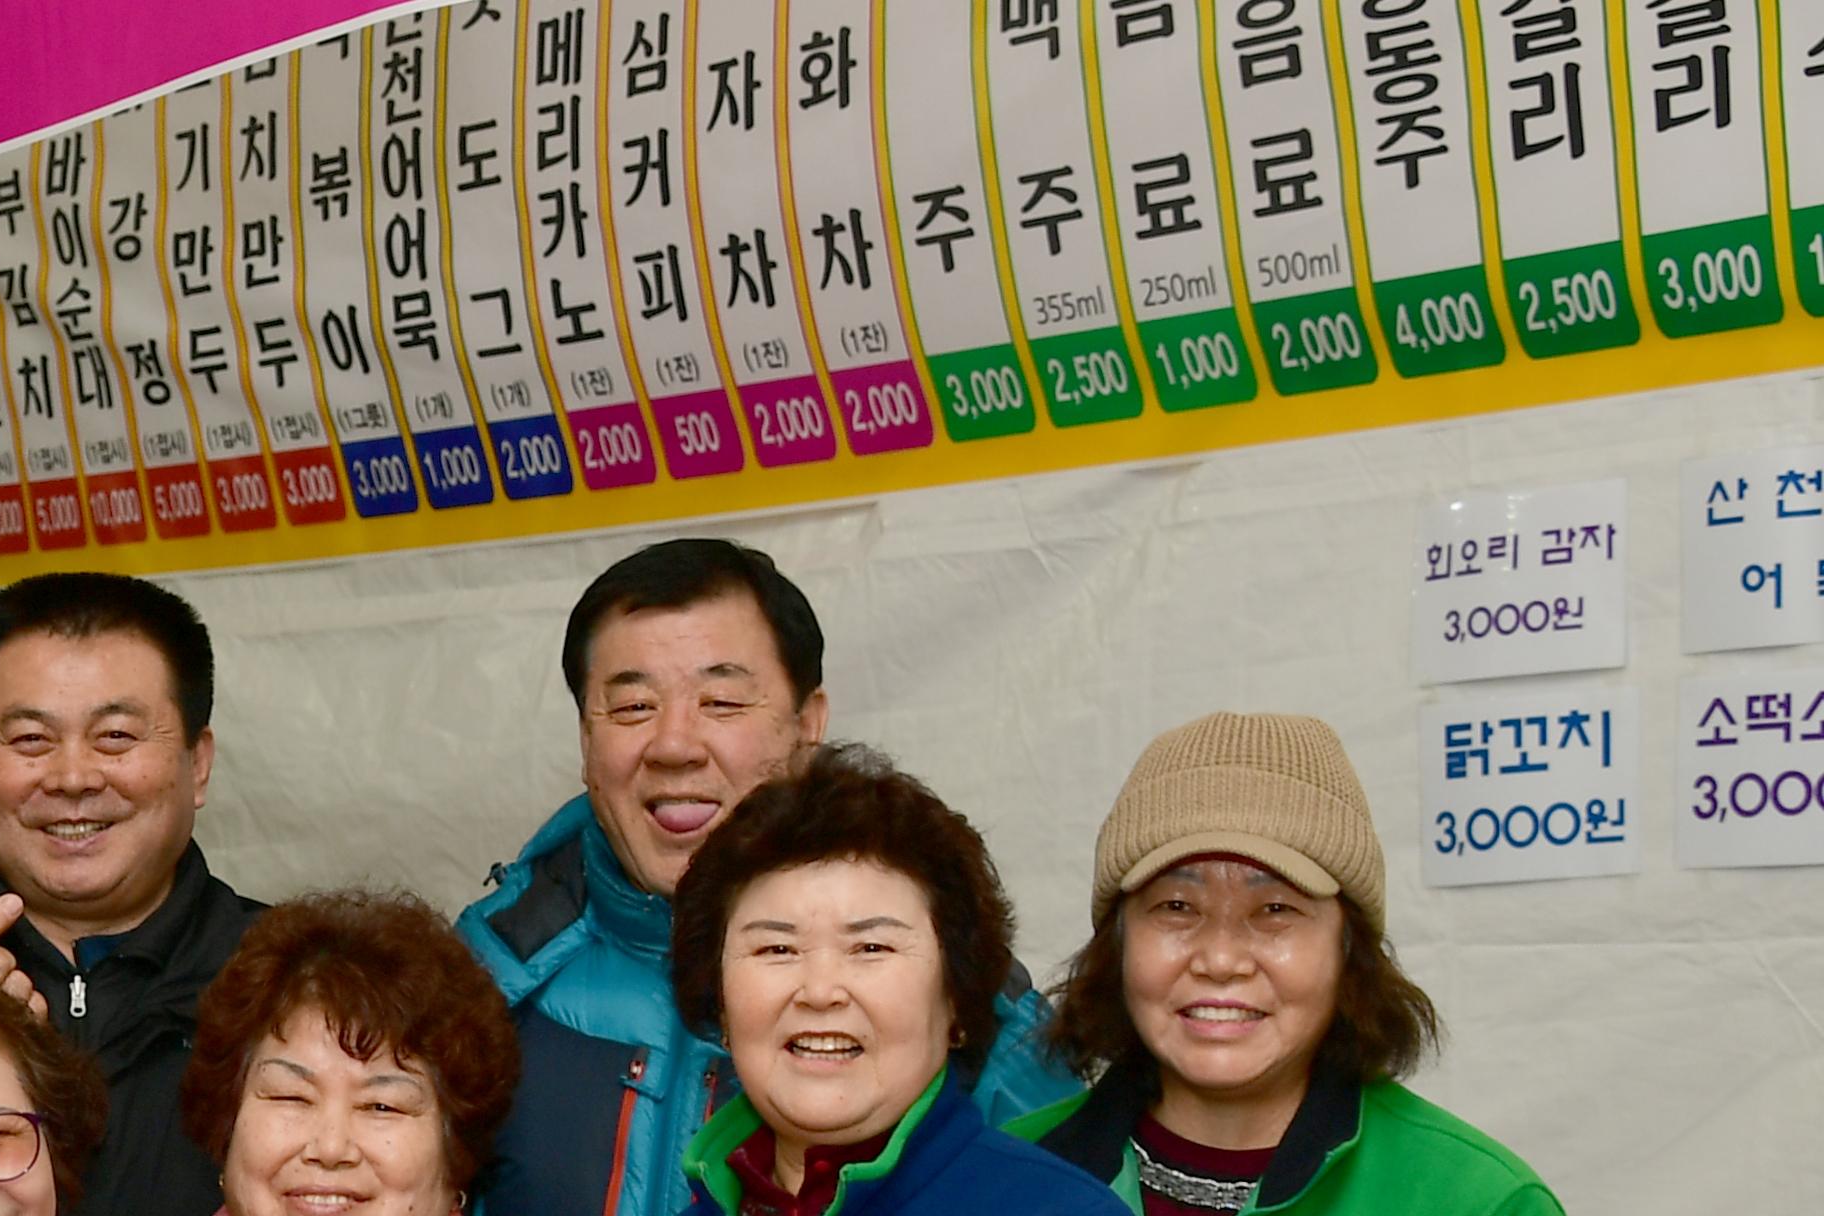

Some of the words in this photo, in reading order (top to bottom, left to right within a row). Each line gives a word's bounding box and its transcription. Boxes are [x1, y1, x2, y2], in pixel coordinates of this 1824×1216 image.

[1232, 0, 1323, 218] 음료
[1362, 0, 1448, 189] 동주
[536, 8, 604, 344] 메리카노
[622, 12, 688, 322] 심커피
[706, 50, 777, 308] 자차
[797, 25, 873, 290] 화차
[309, 33, 369, 374] 볶이
[912, 186, 974, 273] 주
[108, 104, 171, 406] 강정
[173, 82, 228, 394] 기만두
[45, 132, 113, 409] 바이순대
[1143, 266, 1217, 307] 250ml
[1259, 244, 1341, 288] 500ml
[1657, 243, 1763, 313] 3,000
[1033, 287, 1106, 325] 355ml
[1395, 291, 1486, 354] 4,000
[1519, 268, 1617, 335] 2,500
[743, 338, 789, 373] (1잔)
[841, 321, 888, 358] (1잔)
[1156, 332, 1240, 388] 1,000
[1272, 312, 1362, 370] 2,000
[491, 379, 531, 410] (1개)
[572, 367, 614, 399] (1잔)
[656, 353, 700, 387] (1잔)
[946, 366, 1022, 418] 3,000
[1047, 349, 1128, 406] 2,500
[337, 402, 388, 430] (1그릇)
[415, 390, 454, 422] (1개)
[754, 396, 824, 447] 2,000
[845, 381, 919, 435] 2,000
[501, 434, 561, 480] 2,000
[579, 423, 642, 471] 2,000
[674, 411, 720, 455] 500
[217, 472, 267, 514] 3,000
[283, 464, 336, 506] 3,000
[353, 455, 408, 498] 3,000
[425, 445, 480, 491] 1,000
[35, 494, 80, 533] 5,000
[90, 487, 142, 527] 10,000
[154, 480, 203, 521] 5,000
[1425, 533, 1519, 582] 회오리
[1541, 523, 1617, 566] 감자
[1444, 596, 1584, 642] 3,000원
[1444, 709, 1611, 780] 닭꼬치
[1693, 769, 1824, 822] 3,00
[1435, 798, 1625, 856] 3,000원
